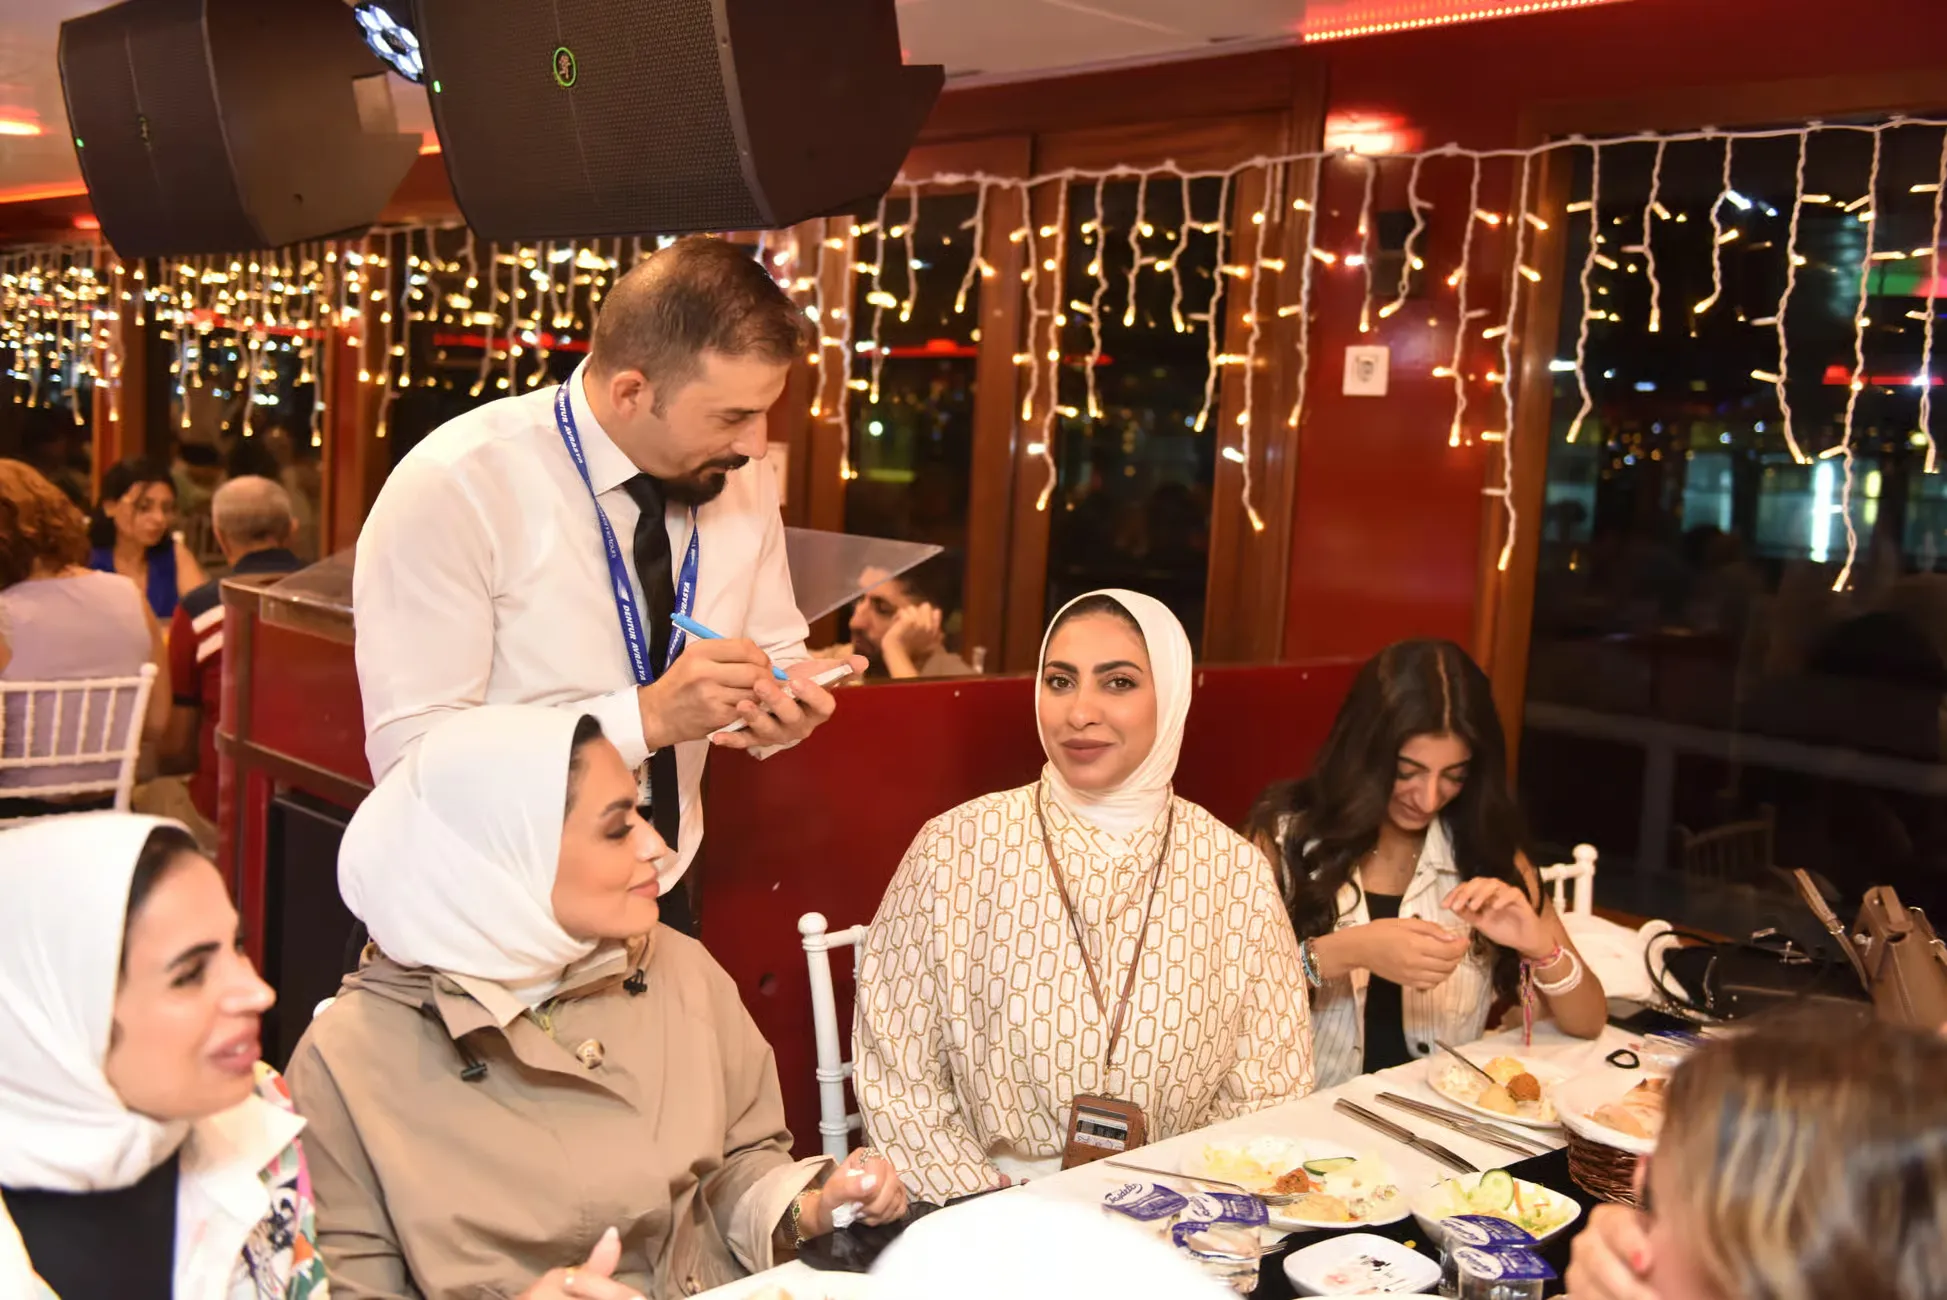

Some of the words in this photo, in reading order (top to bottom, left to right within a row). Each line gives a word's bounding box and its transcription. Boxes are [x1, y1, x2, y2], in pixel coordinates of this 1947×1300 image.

[564, 425, 583, 464] AVRASYA
[623, 604, 637, 640] DENTUR
[631, 642, 646, 681] AVRASYA
